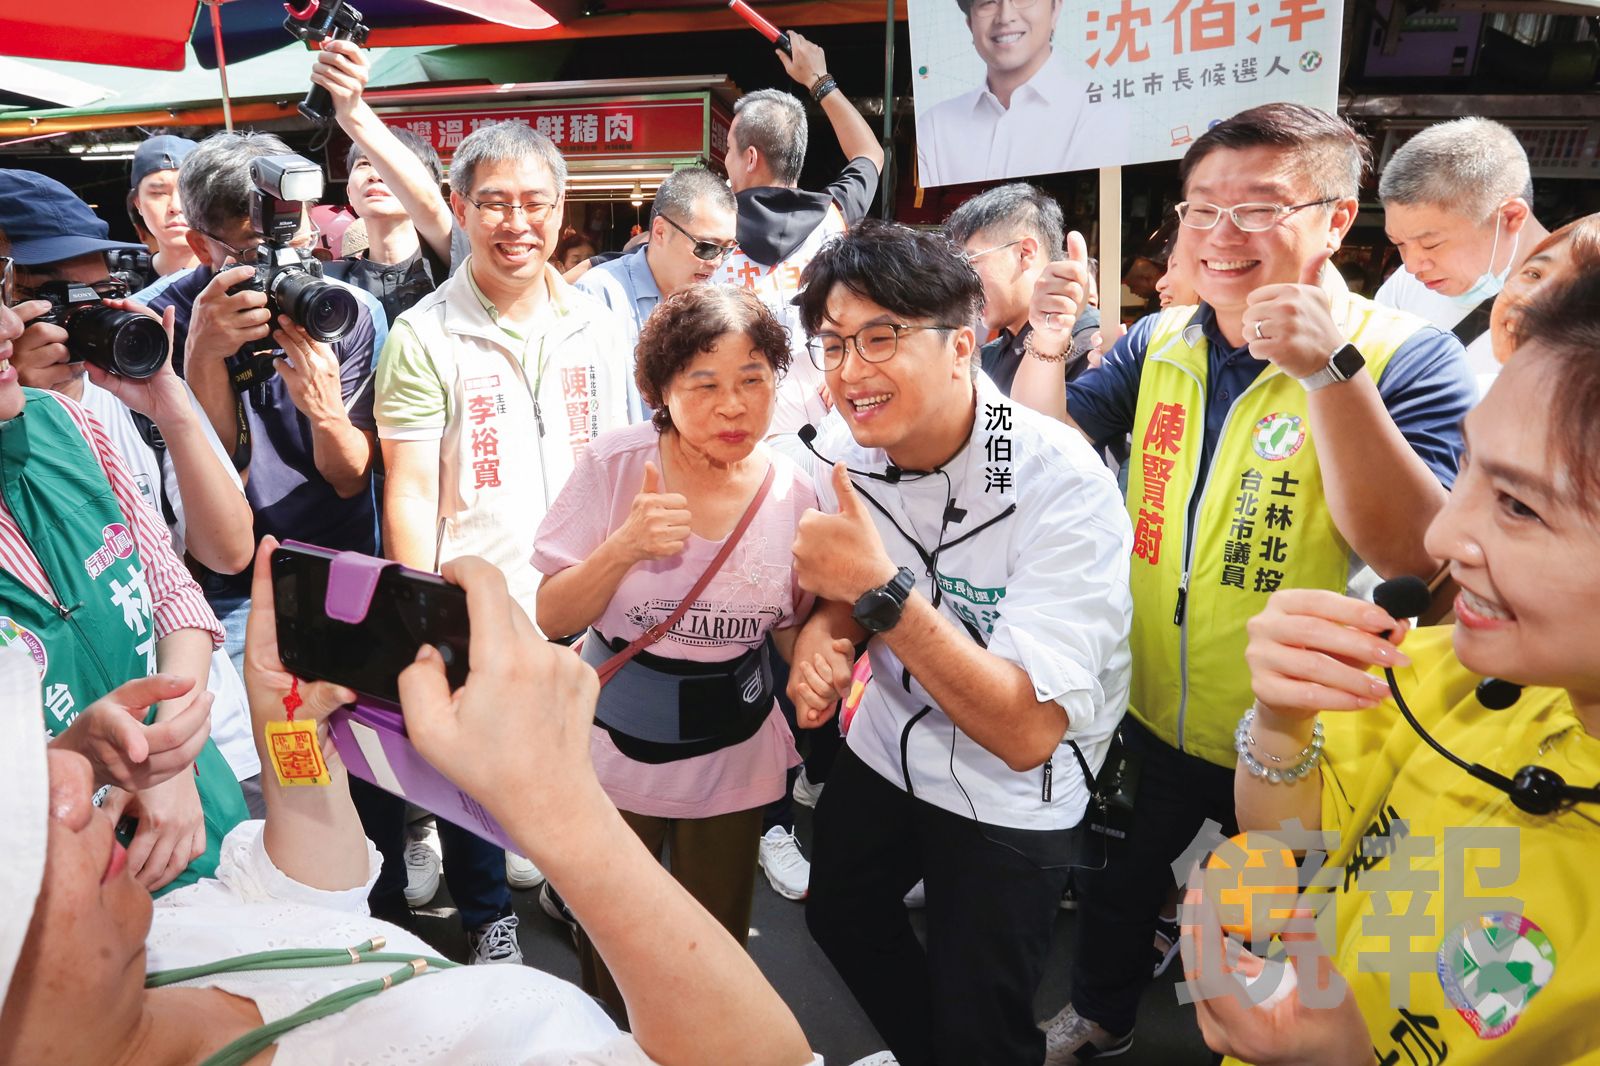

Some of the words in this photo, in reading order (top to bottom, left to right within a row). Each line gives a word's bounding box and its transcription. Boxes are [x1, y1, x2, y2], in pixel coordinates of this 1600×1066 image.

[1085, 56, 1291, 104] 台北市長候選人
[467, 393, 503, 490] 李裕寬
[1131, 401, 1187, 566] 陳賢蔚
[1220, 467, 1263, 590] 台北市議員
[1253, 470, 1300, 593] 士林北投
[688, 615, 762, 640] JARDIN
